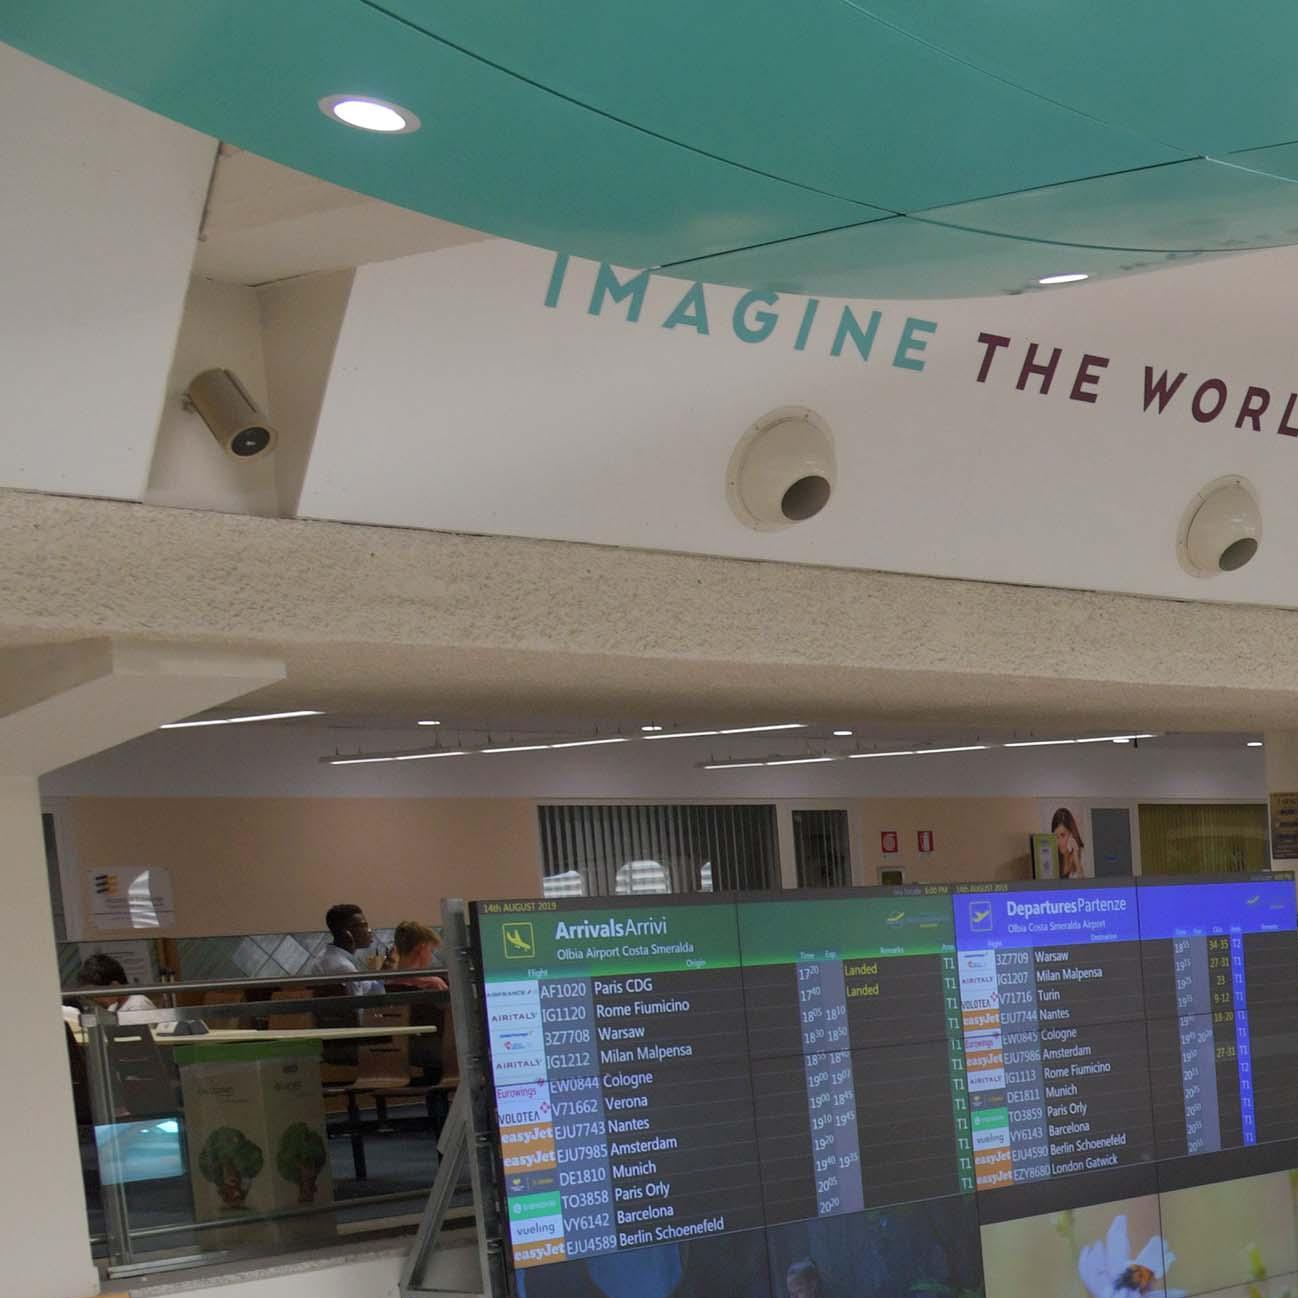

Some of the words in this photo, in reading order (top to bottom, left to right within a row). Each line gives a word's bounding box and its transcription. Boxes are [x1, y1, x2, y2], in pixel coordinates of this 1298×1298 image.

[544, 253, 938, 372] IMAGINE
[976, 333, 1110, 405] THE
[557, 948, 584, 961] Olbia
[586, 946, 620, 961] Airport
[622, 945, 649, 957] Costa
[651, 942, 694, 956] Smeralda
[1035, 951, 1069, 963] Warsaw
[541, 983, 587, 999] AF1020
[594, 980, 623, 995] Paris
[626, 978, 653, 993] CDG
[844, 964, 878, 977] Landed
[1037, 971, 1061, 982] Milan
[1062, 967, 1103, 981] Malpensa
[542, 1006, 587, 1023] IG1120
[597, 1004, 631, 1018] Rome
[634, 999, 690, 1016] Fiumicino
[846, 984, 880, 998] Landed
[1038, 989, 1061, 1001] Turin
[1040, 1009, 1070, 1021] Nantes
[598, 1026, 645, 1041] Warsaw
[1041, 1029, 1077, 1042] Cologne
[547, 1053, 591, 1070] IG1212
[601, 1049, 635, 1064] Milan
[637, 1043, 693, 1062] Malpensa
[1043, 1045, 1091, 1060] Amsterdam
[1044, 1068, 1069, 1080] Rome
[1071, 1062, 1111, 1076] Fiumicino
[497, 1086, 537, 1099] Eurowings
[550, 1077, 600, 1095] EW0844
[603, 1072, 653, 1090] Cologne
[1046, 1084, 1078, 1099] Munich
[552, 1099, 599, 1117] V71662
[605, 1095, 649, 1110] Verona
[1047, 1105, 1068, 1117] Paris
[1070, 1102, 1088, 1116] Orly
[500, 1128, 553, 1144] easyJet
[555, 1121, 606, 1140] EJU7743
[608, 1118, 650, 1134] Nantes
[1049, 1122, 1090, 1137] Barcelona
[503, 1151, 556, 1168] easyJet
[557, 1145, 608, 1164] EJU7985
[610, 1136, 678, 1156] Amsterdam
[1050, 1143, 1075, 1156] Berlin
[1077, 1134, 1127, 1151] Schoenefeld
[560, 1168, 607, 1187] DE1810
[612, 1161, 657, 1179] Munich
[1052, 1161, 1084, 1175] London
[1085, 1155, 1119, 1169] Gatwick
[561, 1190, 610, 1209] TO3858
[615, 1185, 643, 1202] Paris
[645, 1181, 671, 1200] Orly
[517, 1223, 556, 1237] vueling
[563, 1213, 611, 1232] VY6142
[617, 1204, 674, 1224] Barcelona
[513, 1244, 566, 1261] easyJet
[567, 1236, 618, 1255] EJU4589
[620, 1229, 653, 1247] Berlin
[655, 1216, 725, 1241] Schoenefeld
